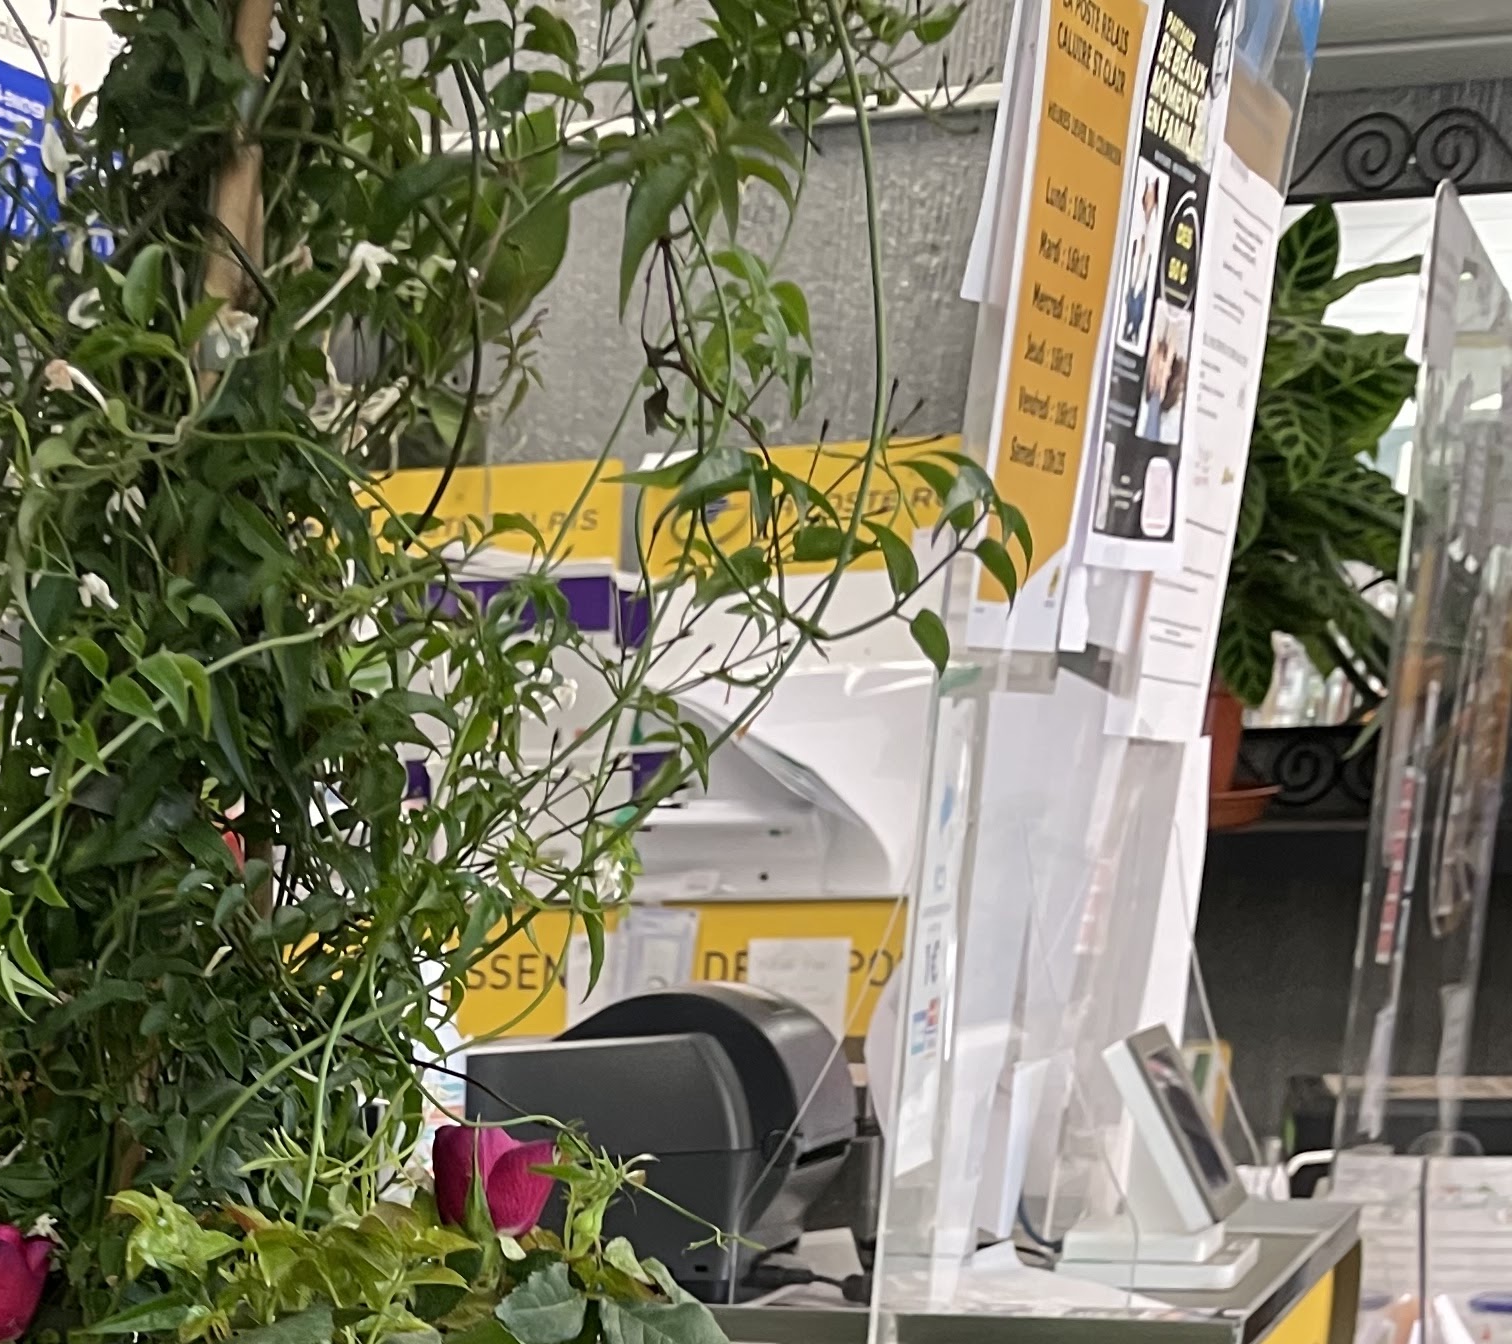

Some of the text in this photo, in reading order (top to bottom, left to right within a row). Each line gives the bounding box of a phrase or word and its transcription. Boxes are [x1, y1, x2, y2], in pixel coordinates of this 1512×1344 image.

[1149, 64, 1206, 126] MOMENT
[1156, 31, 1210, 99] DE BEAUX
